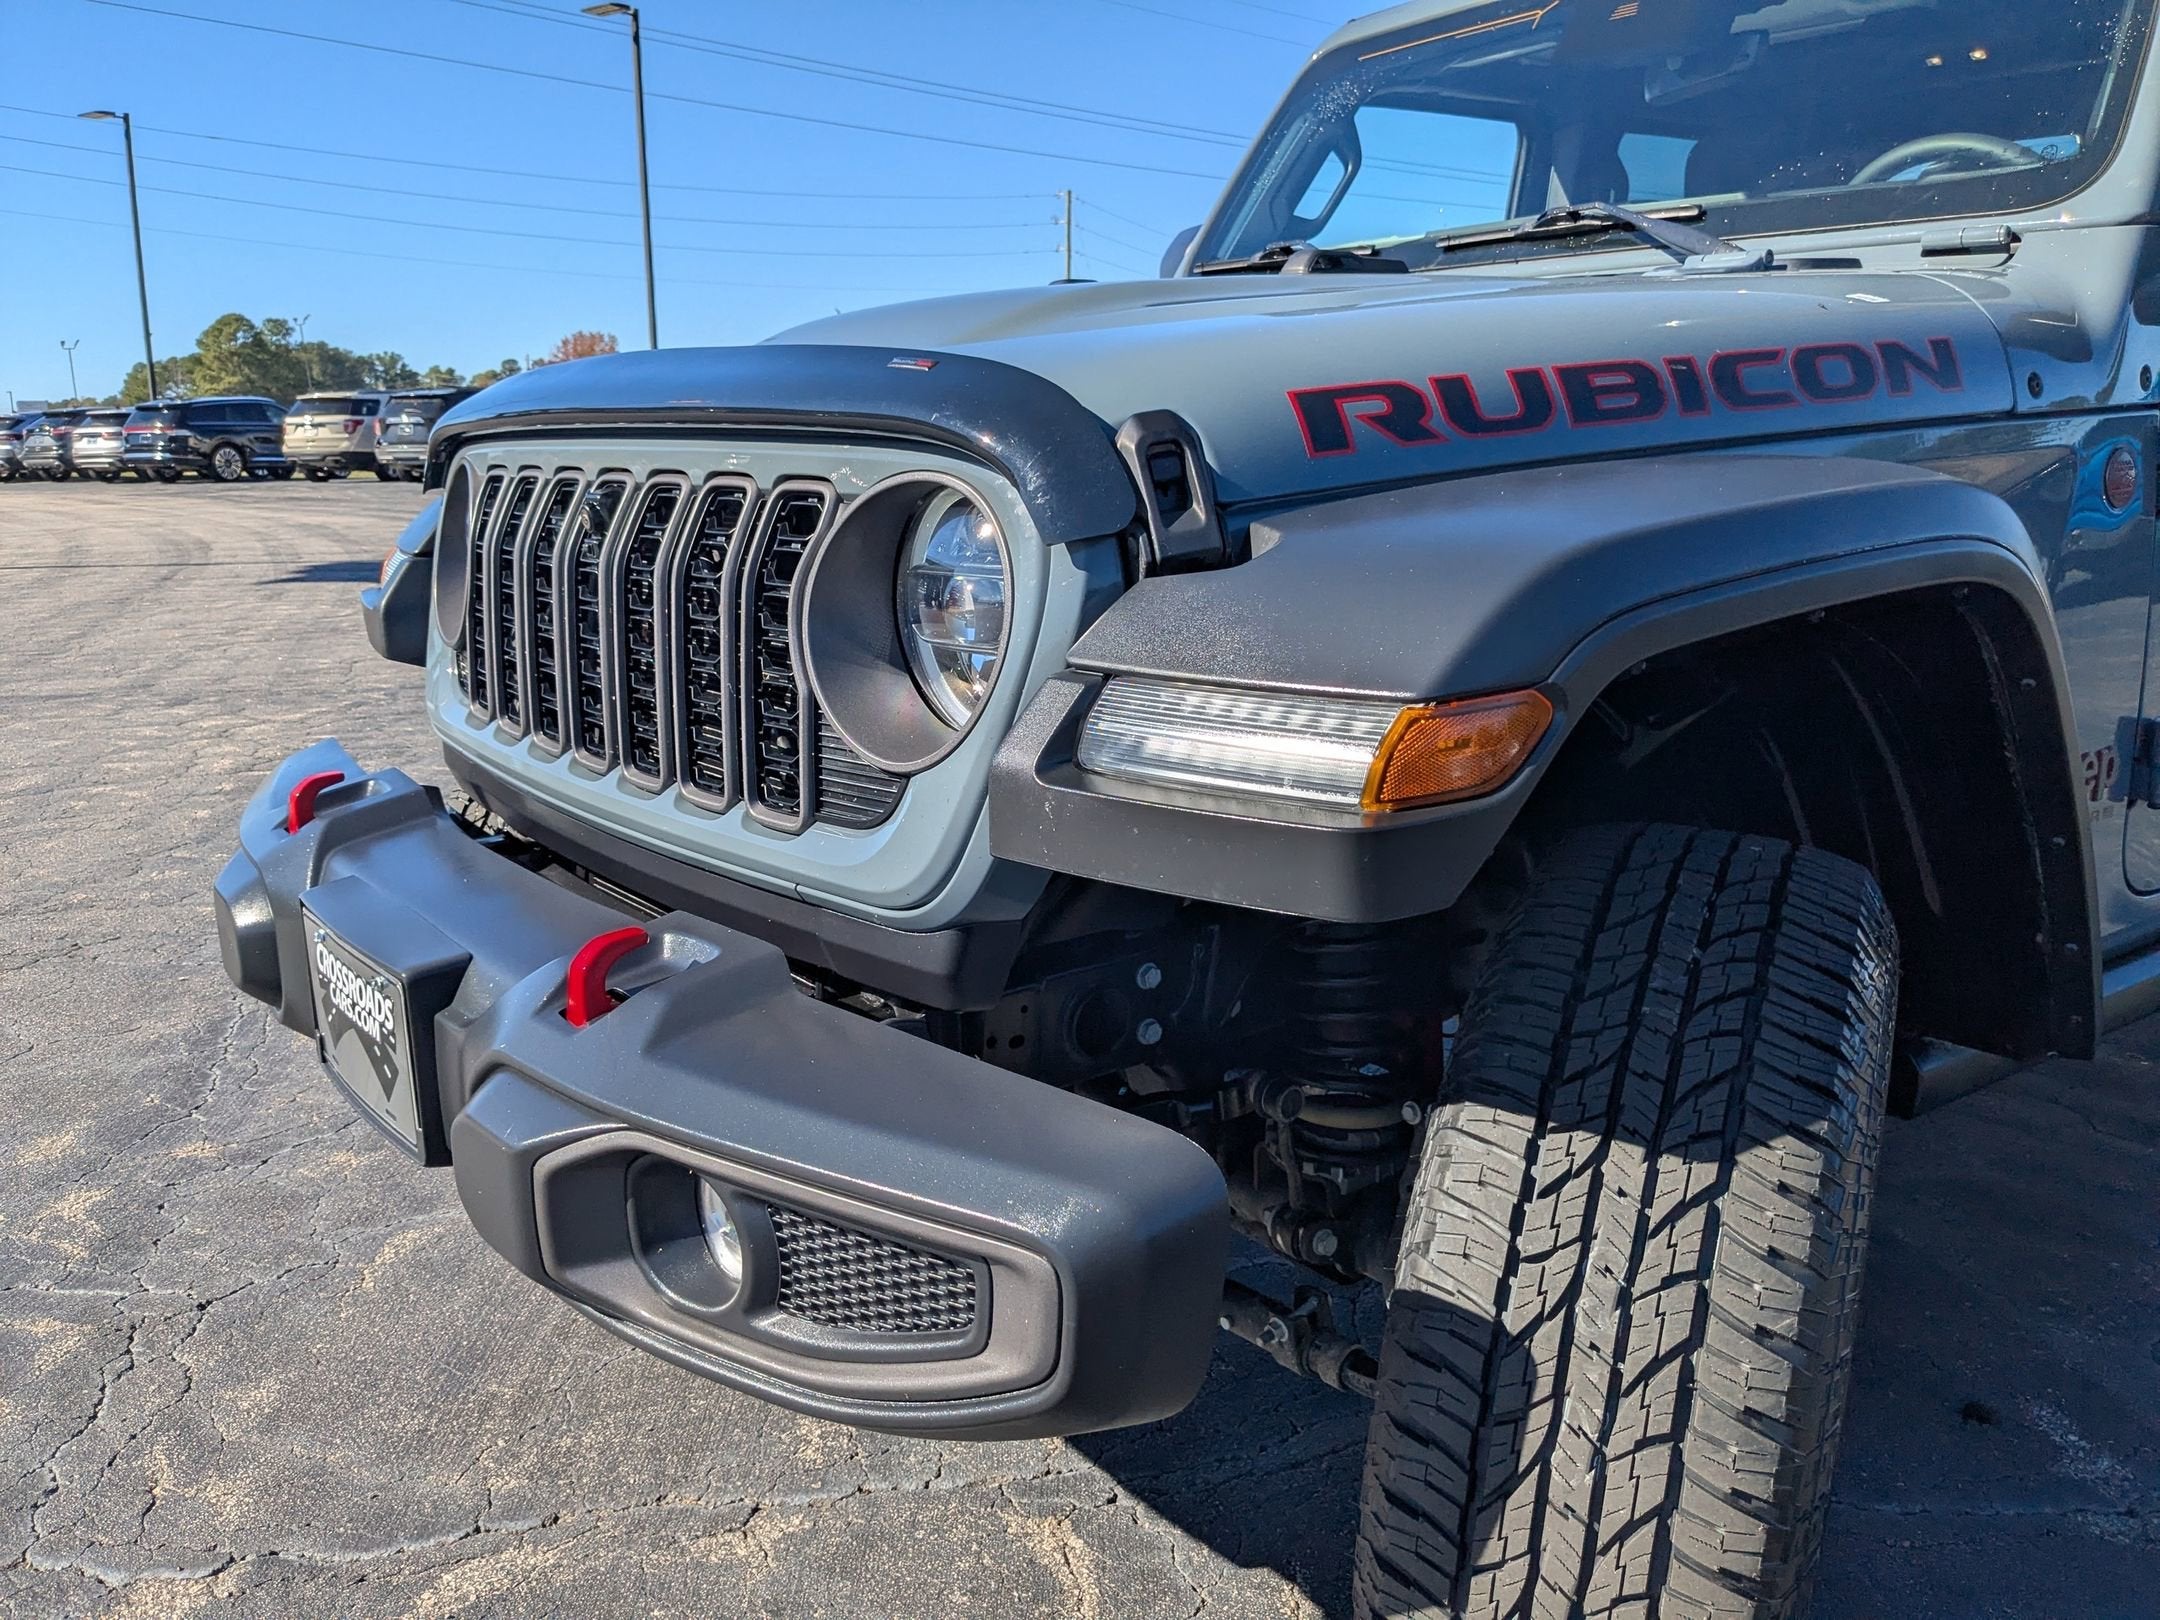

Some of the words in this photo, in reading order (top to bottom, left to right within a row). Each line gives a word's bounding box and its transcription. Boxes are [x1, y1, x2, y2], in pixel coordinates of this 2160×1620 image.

[1287, 337, 1965, 459] RUBICON
[316, 943, 394, 1030] CROSSROADS
[330, 982, 380, 1042] CARS.COM
